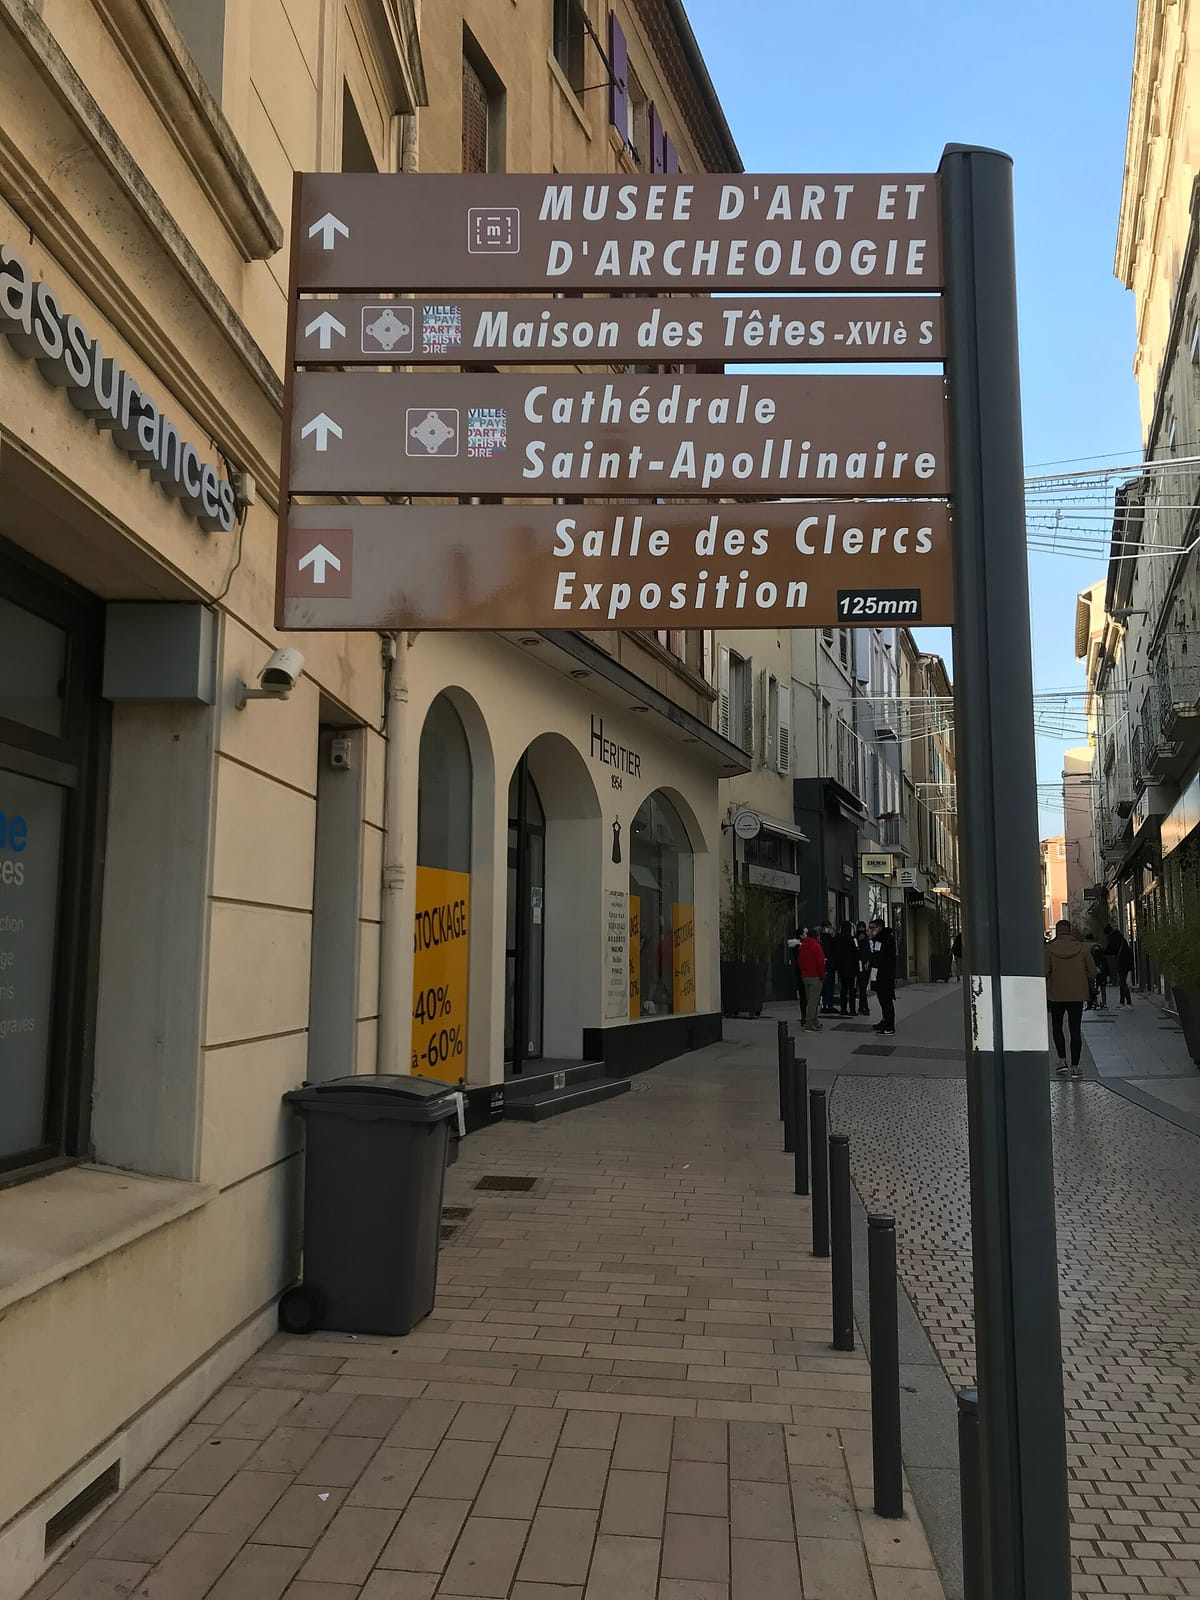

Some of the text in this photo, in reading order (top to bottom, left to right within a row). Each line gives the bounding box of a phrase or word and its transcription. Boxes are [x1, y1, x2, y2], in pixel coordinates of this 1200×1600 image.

[538, 184, 926, 221] MUSEE D'ART ET
[546, 239, 927, 276] D'ARCHEOLOGIE
[473, 310, 620, 348] Maison
[637, 308, 704, 348] des
[722, 309, 826, 348] Têtes
[919, 320, 934, 346] S
[0, 244, 234, 532] assurances
[523, 384, 777, 425] Cathédrale
[522, 439, 936, 489] Saint-Apollinaire
[553, 514, 934, 557] Salle des Clercs
[553, 570, 918, 620] Exposition 125mm
[590, 713, 641, 779] HERITIER
[414, 900, 467, 953] TOCKAGE
[420, 1024, 464, 1067] -60%
